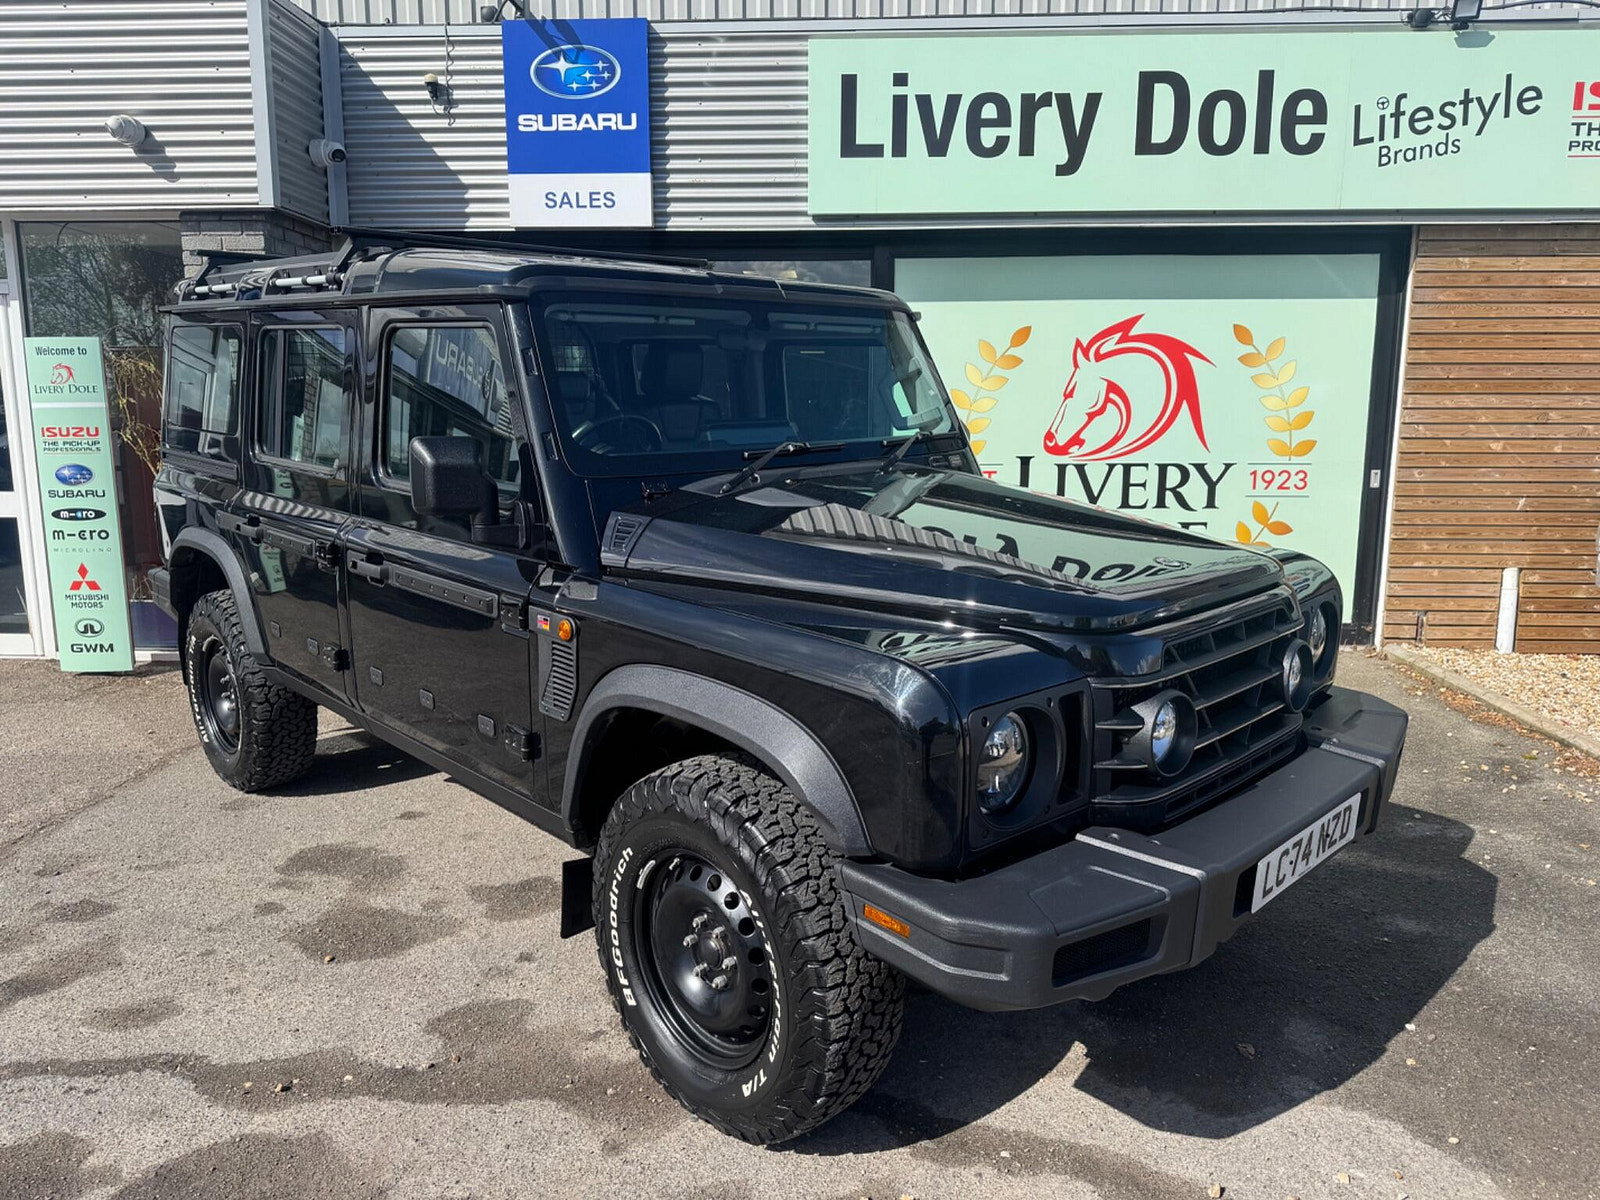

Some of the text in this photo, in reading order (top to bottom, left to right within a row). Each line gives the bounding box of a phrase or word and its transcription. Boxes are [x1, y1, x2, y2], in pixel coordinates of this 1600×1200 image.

[1352, 73, 1543, 147] Lifestyle
[517, 112, 637, 132] SUBARU
[840, 69, 1328, 177] Livery Dole
[1377, 132, 1461, 168] Brands
[544, 191, 616, 209] SALES
[35, 346, 87, 356] Welcome to
[34, 384, 98, 394] LIVERY DOLE
[41, 426, 99, 438] ISUZU
[1015, 455, 1238, 512] LIVERY
[1249, 469, 1309, 491] 1923
[48, 489, 106, 498] SUBARU
[70, 643, 114, 653] GWM
[1262, 803, 1353, 899] LC74 NZD
[742, 1068, 768, 1098] T/A
